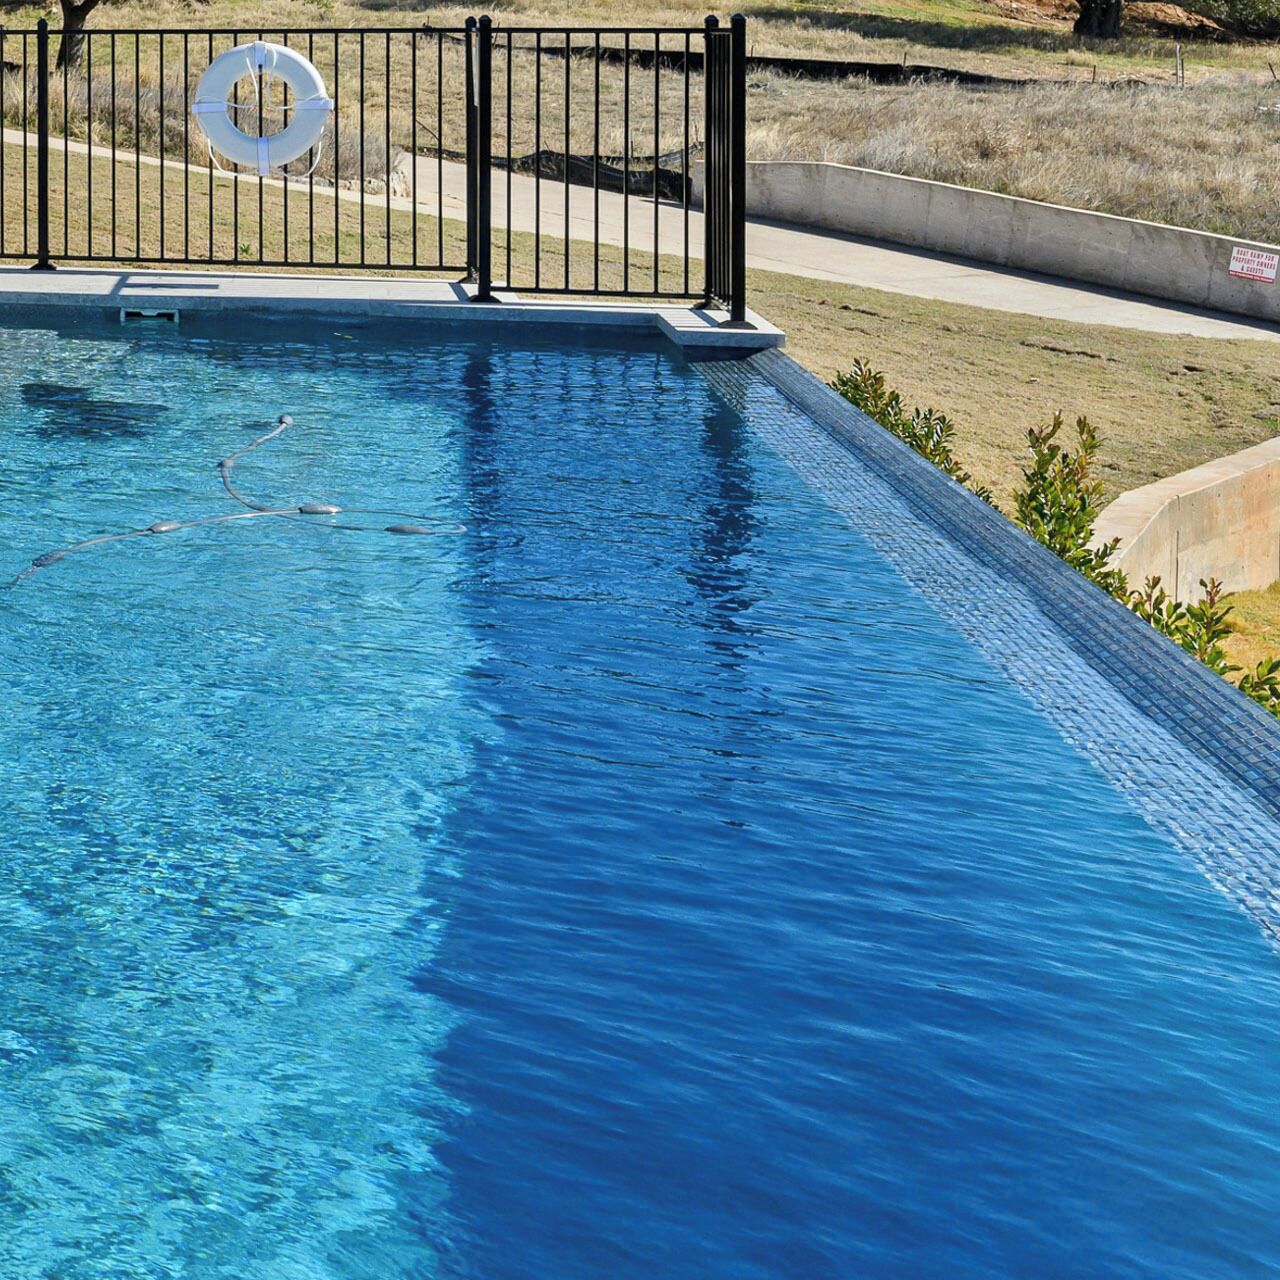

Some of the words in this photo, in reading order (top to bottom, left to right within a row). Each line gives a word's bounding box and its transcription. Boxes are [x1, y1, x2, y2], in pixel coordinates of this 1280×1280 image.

[1232, 255, 1256, 265] PROPERTY
[1256, 260, 1276, 270] OWNERS
[1265, 254, 1275, 262] FOR
[1246, 266, 1264, 275] GUESTS
